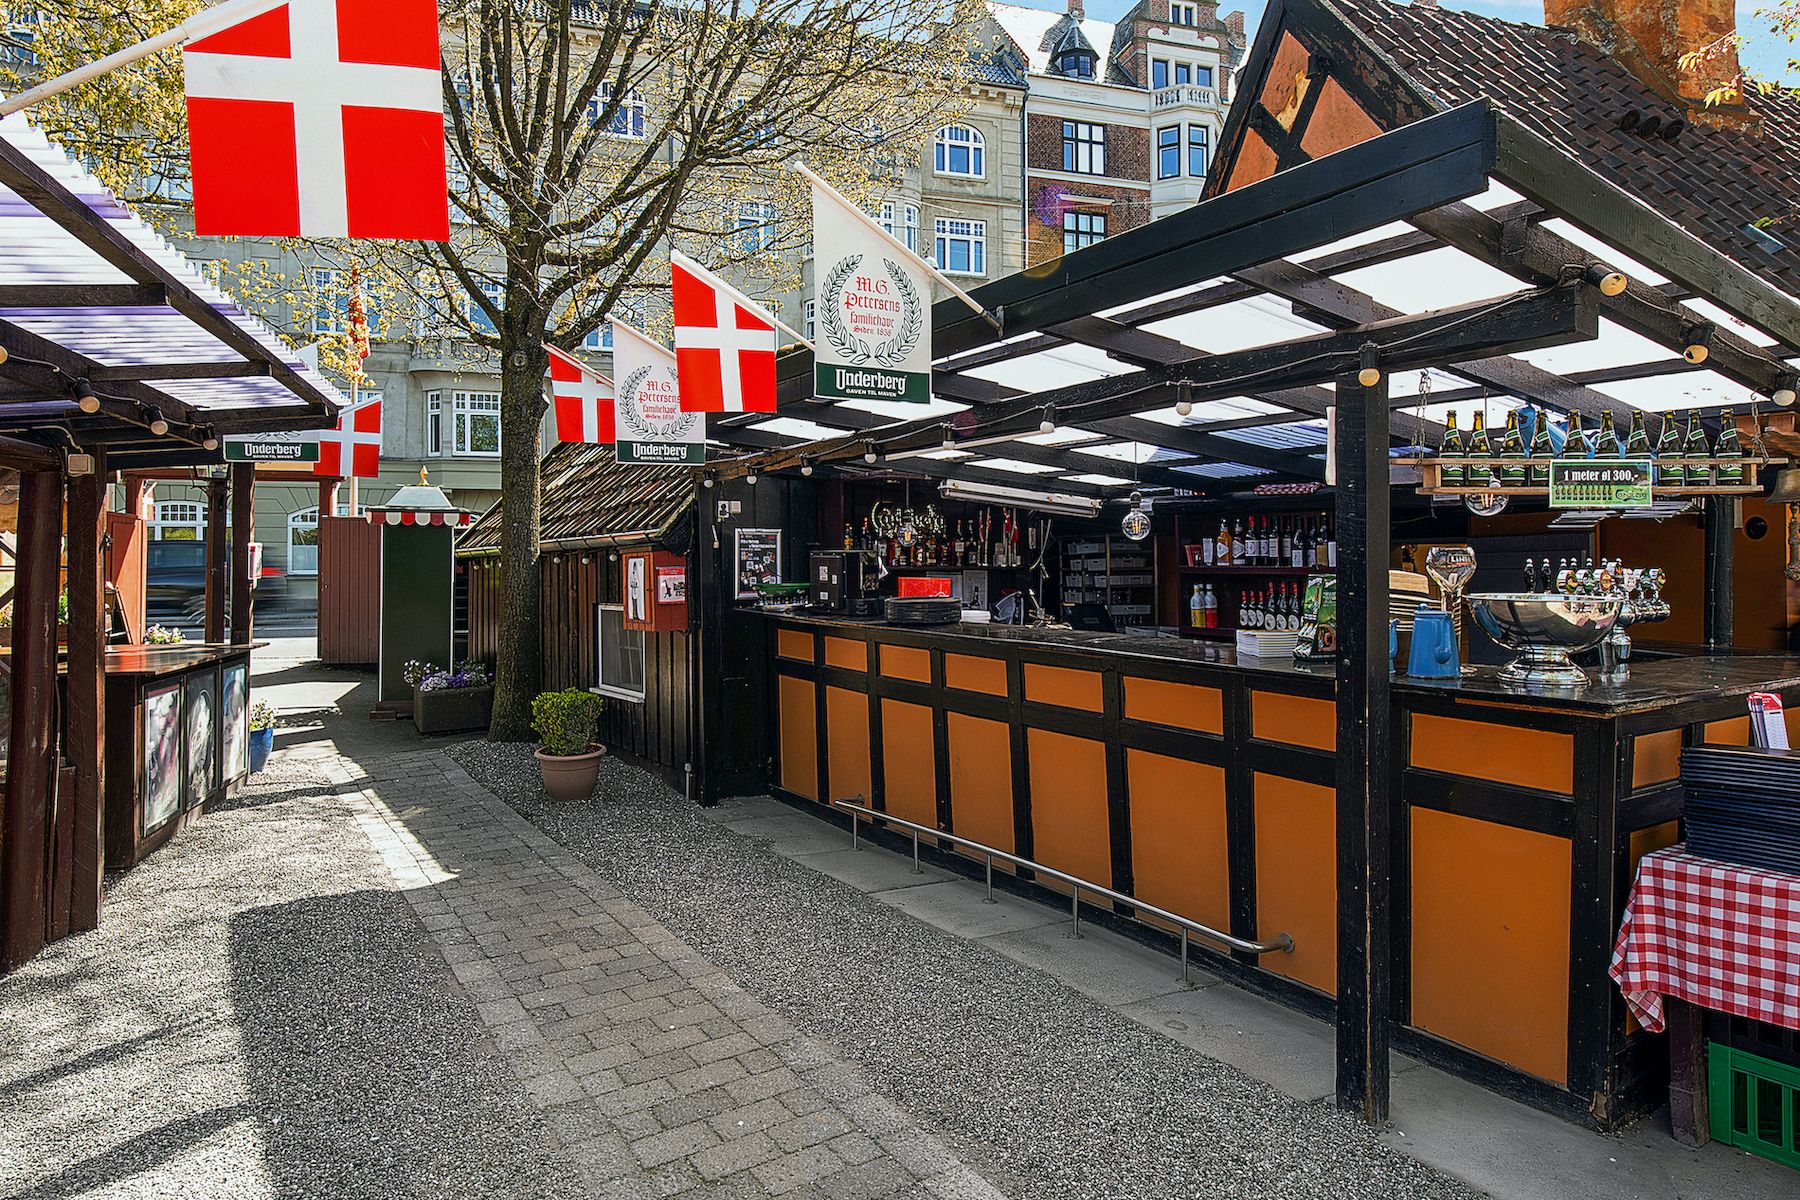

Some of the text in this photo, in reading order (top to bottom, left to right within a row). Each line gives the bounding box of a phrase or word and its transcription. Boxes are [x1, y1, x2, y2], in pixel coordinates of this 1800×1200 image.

[855, 276, 890, 295] M.G.
[844, 291, 901, 313] Petersens
[835, 368, 907, 395] Underberg
[244, 443, 302, 457] Underberg
[632, 443, 688, 459] Underberg
[1564, 469, 1638, 482] 1 meter øl 300,-
